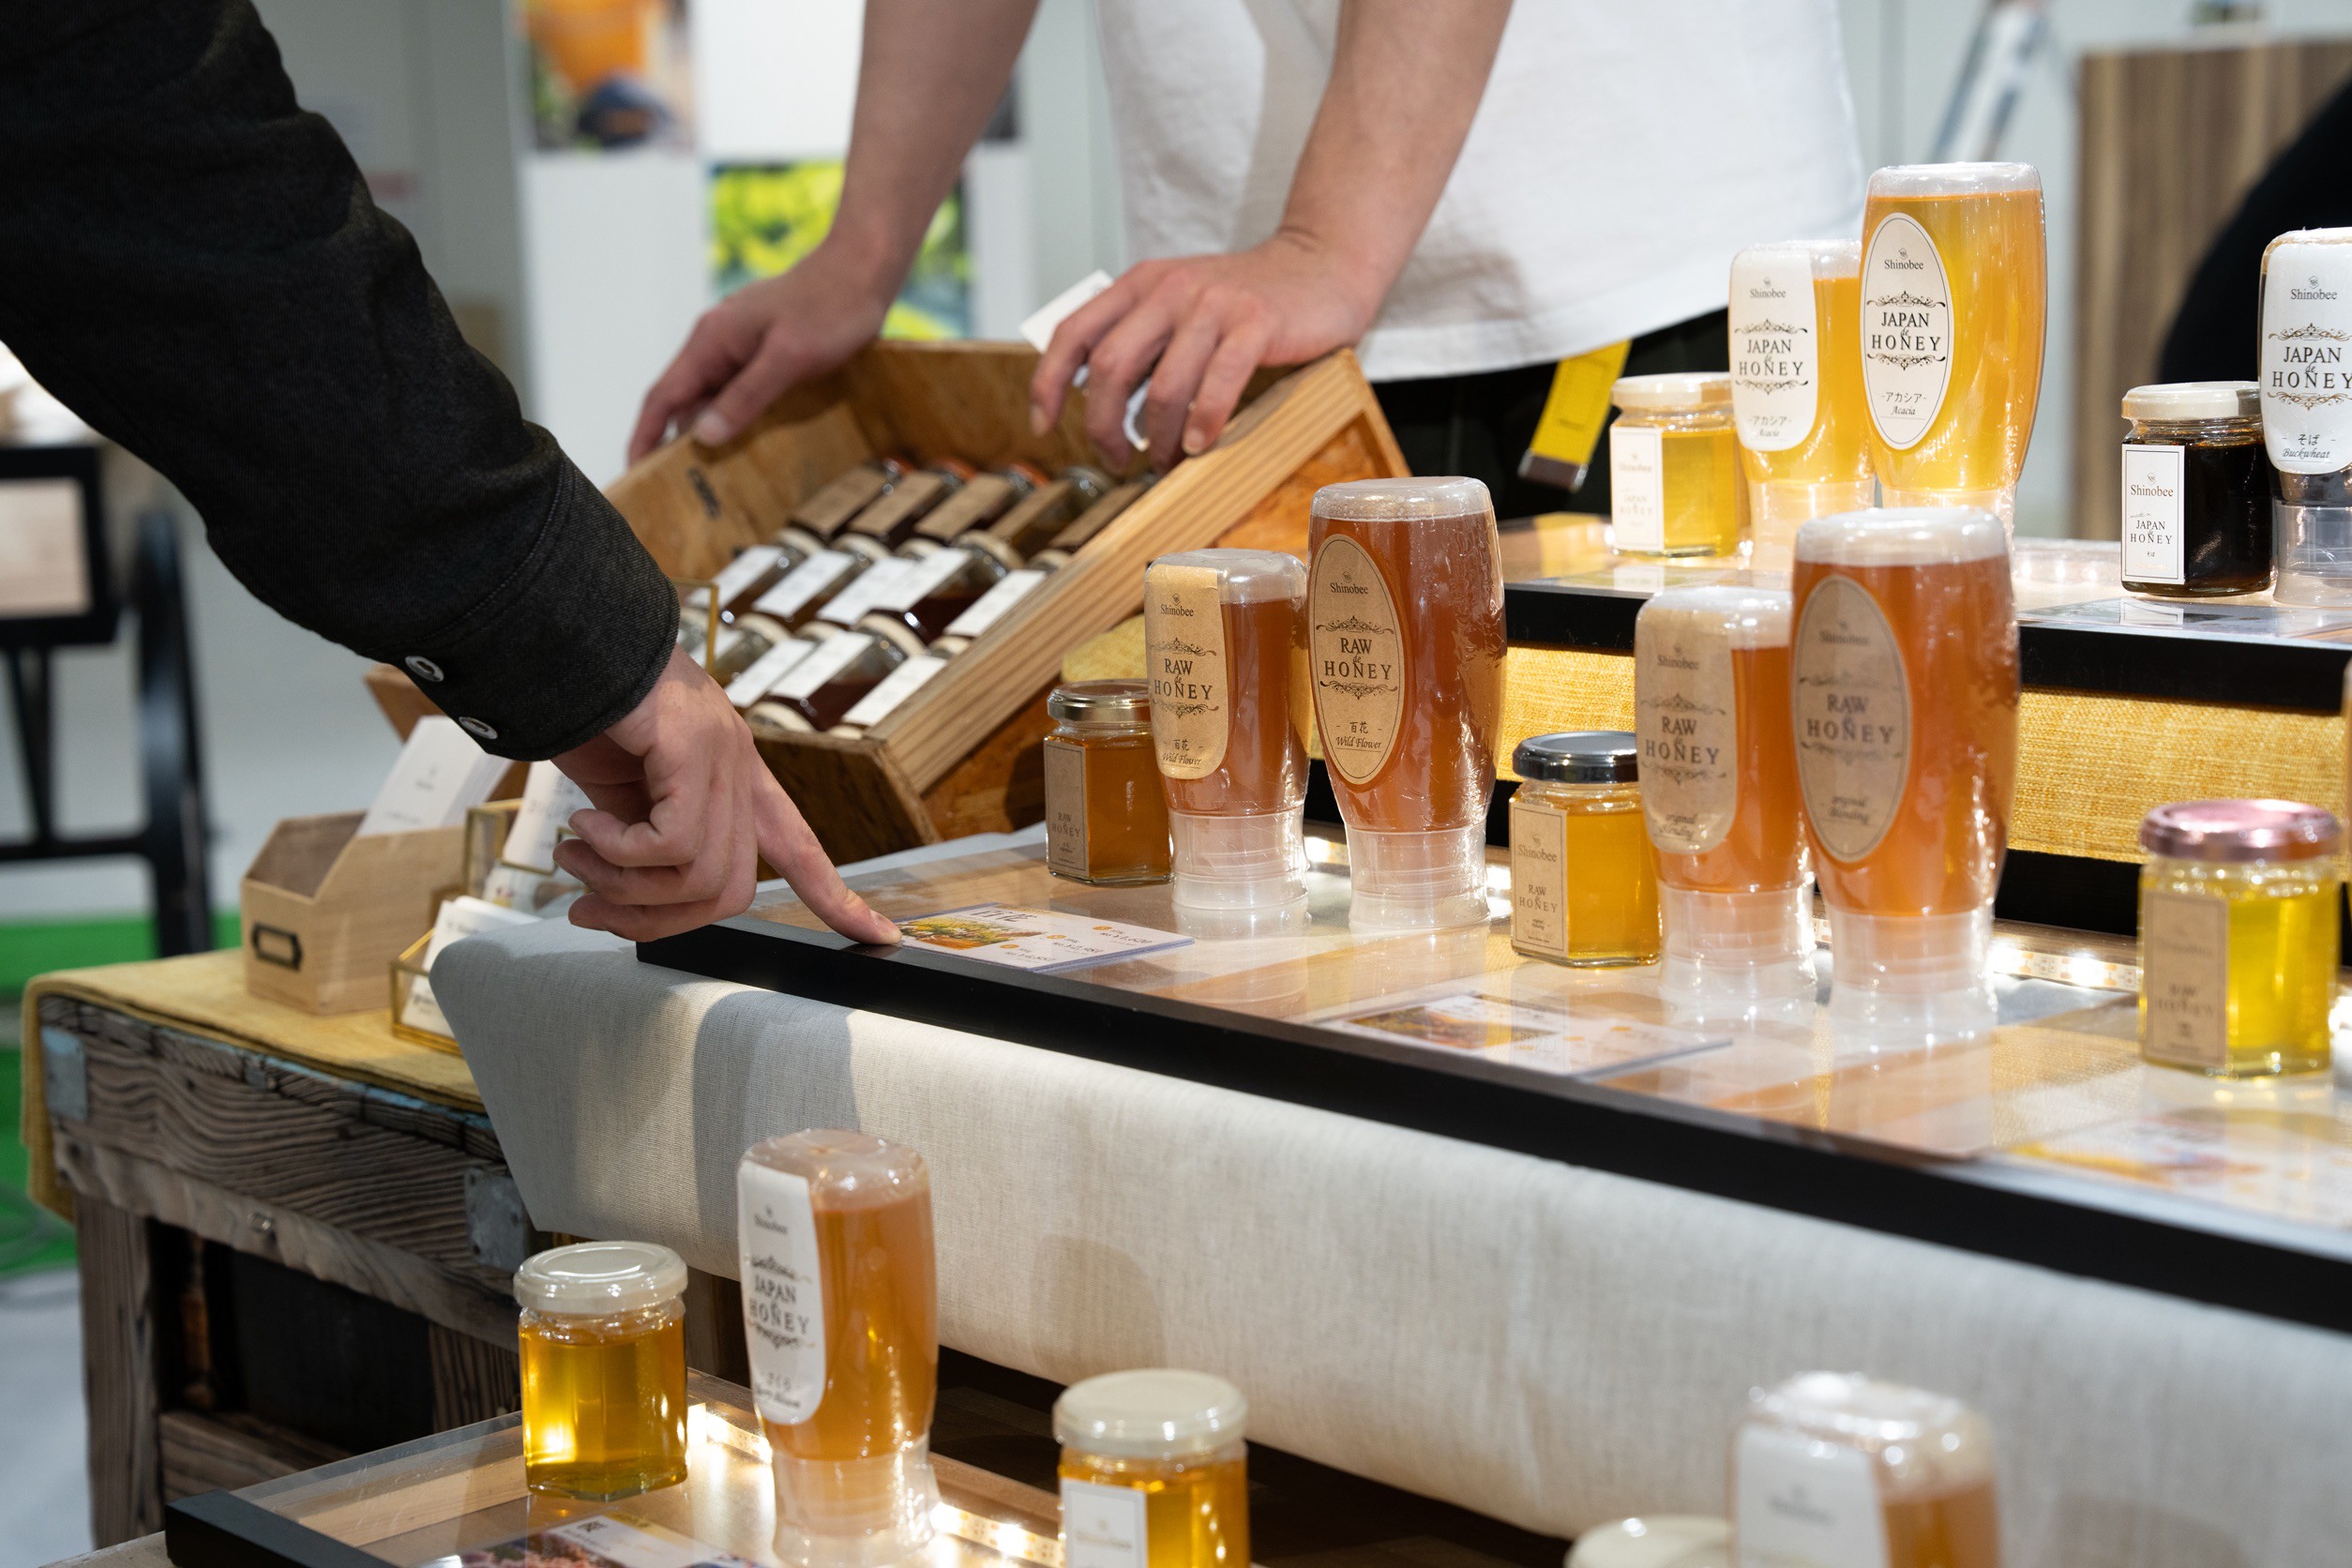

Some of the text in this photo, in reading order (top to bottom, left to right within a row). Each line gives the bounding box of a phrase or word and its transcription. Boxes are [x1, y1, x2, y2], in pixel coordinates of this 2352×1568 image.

[1884, 259, 1924, 271] Shinobee
[1749, 288, 1787, 299] Shinobee
[2290, 288, 2338, 301] Shinobee
[1880, 311, 1930, 328] JAPAN
[1746, 338, 1792, 354] JAPAN
[1871, 334, 1942, 352] HONEY
[2283, 346, 2343, 364] JAPAN
[1739, 361, 1803, 376] HONEY
[2304, 362, 2316, 374] de
[2271, 370, 2352, 389] HONEY
[1891, 405, 1916, 416] Acacia
[2282, 447, 2331, 460] Buckwheat
[2130, 484, 2174, 497] Shinobee
[2136, 520, 2166, 531] JAPAN
[2130, 533, 2173, 545] HONEY
[1330, 581, 1369, 595] Shinobee
[1160, 603, 1195, 618] Shinobee
[1340, 637, 1373, 655] RAW
[1164, 657, 1194, 676] RAW
[1656, 654, 1699, 671] Shinobee
[1323, 660, 1393, 681] HONEY
[1153, 679, 1214, 701] HONEY
[1827, 693, 1870, 715] RAW
[1349, 720, 1369, 734] 百花
[1661, 715, 1697, 736] RAW
[1806, 717, 1896, 745] HONEY
[1172, 739, 1191, 751] 百花
[1335, 735, 1382, 750] Wild Flower
[1161, 751, 1177, 763] Wild
[1645, 738, 1720, 765] HONEY
[1057, 811, 1073, 823] RAW
[1051, 822, 1080, 837] HONEY
[1517, 844, 1558, 863] Shinobee
[1528, 883, 1547, 897] RAW
[1518, 896, 1559, 913] HONEY
[754, 1274, 797, 1304] JAPAN
